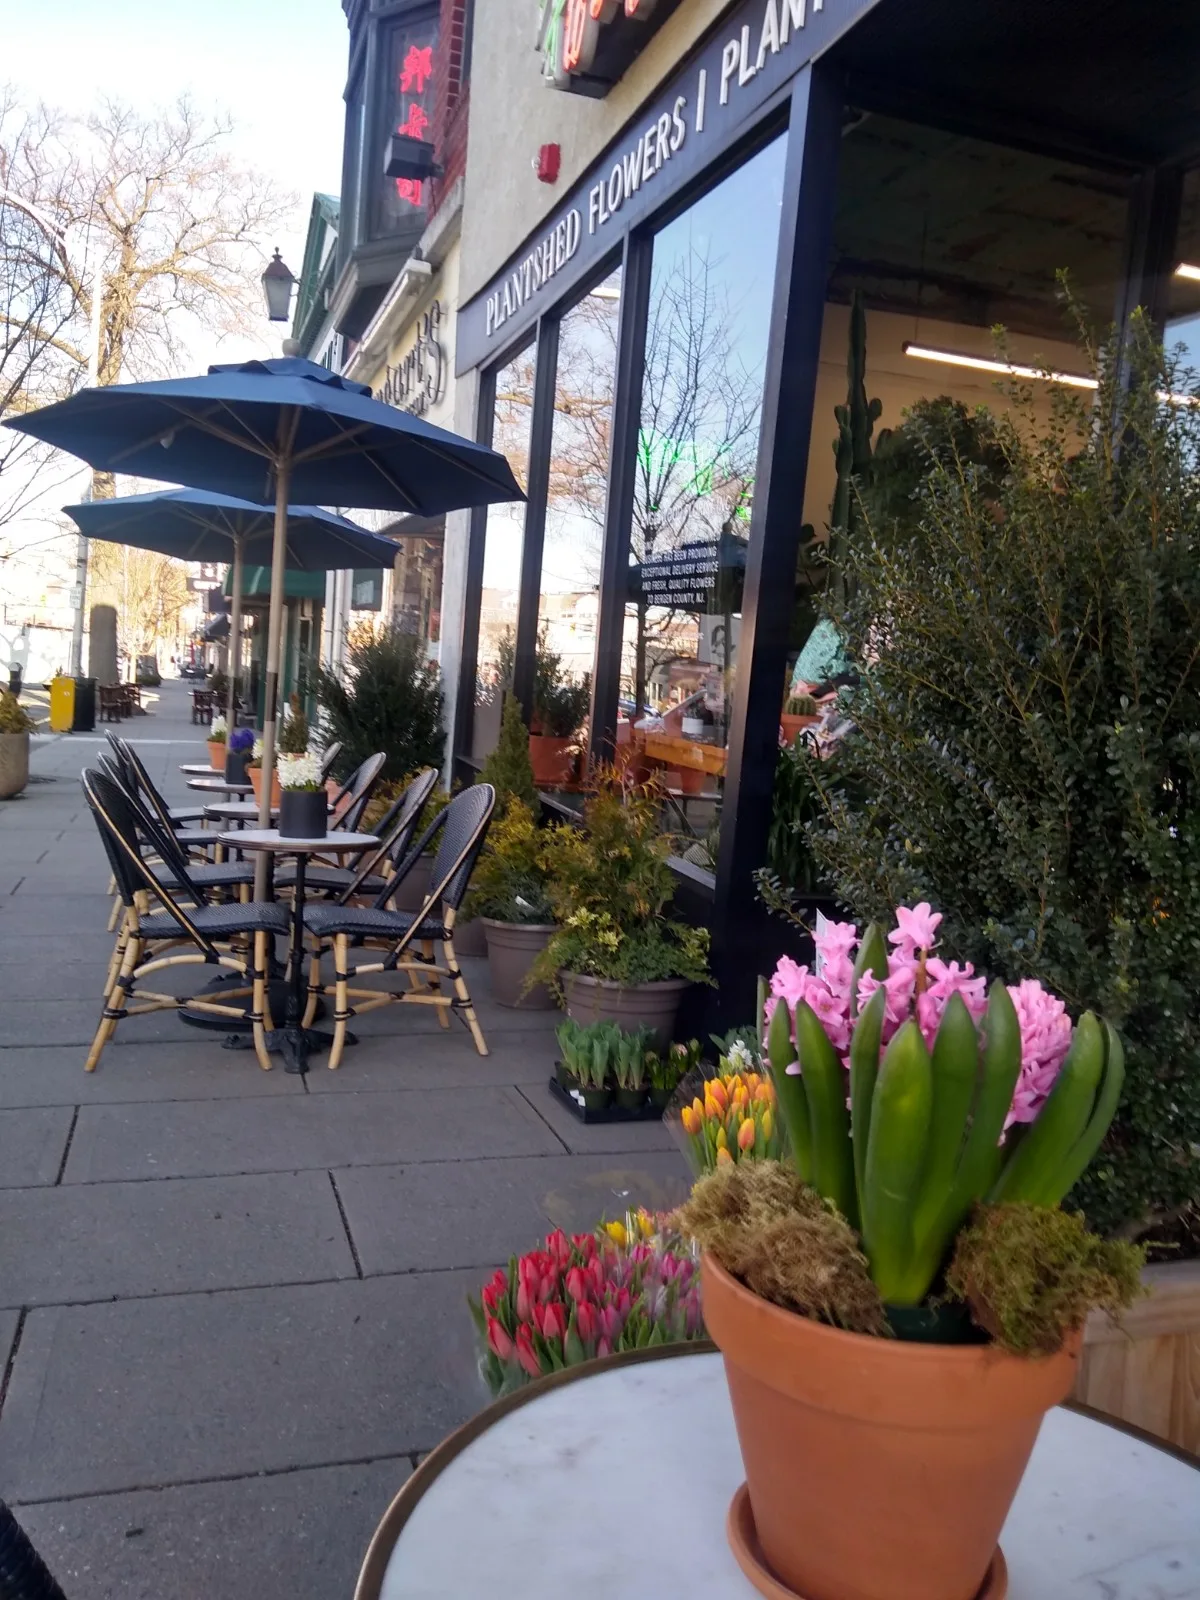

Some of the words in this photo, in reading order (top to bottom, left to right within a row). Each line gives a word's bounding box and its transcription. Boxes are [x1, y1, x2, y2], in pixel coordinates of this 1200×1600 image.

[486, 208, 581, 337] PLANTSHED
[589, 96, 687, 234] FLOWERS
[720, 0, 823, 105] PLAN
[673, 549, 687, 561] BEEN
[687, 547, 717, 558] PROVIDING
[641, 567, 671, 578] EXCEPTIONAL
[672, 563, 695, 576] DELIVERY
[696, 561, 719, 573] SERVICE
[642, 581, 651, 591] AND
[651, 580, 667, 592] FRESH,
[668, 578, 689, 590] QUALITY
[690, 576, 715, 589] FLOWERS
[647, 593, 654, 604] TO
[654, 593, 672, 604] BERGEN
[673, 592, 695, 604] COUNTY,
